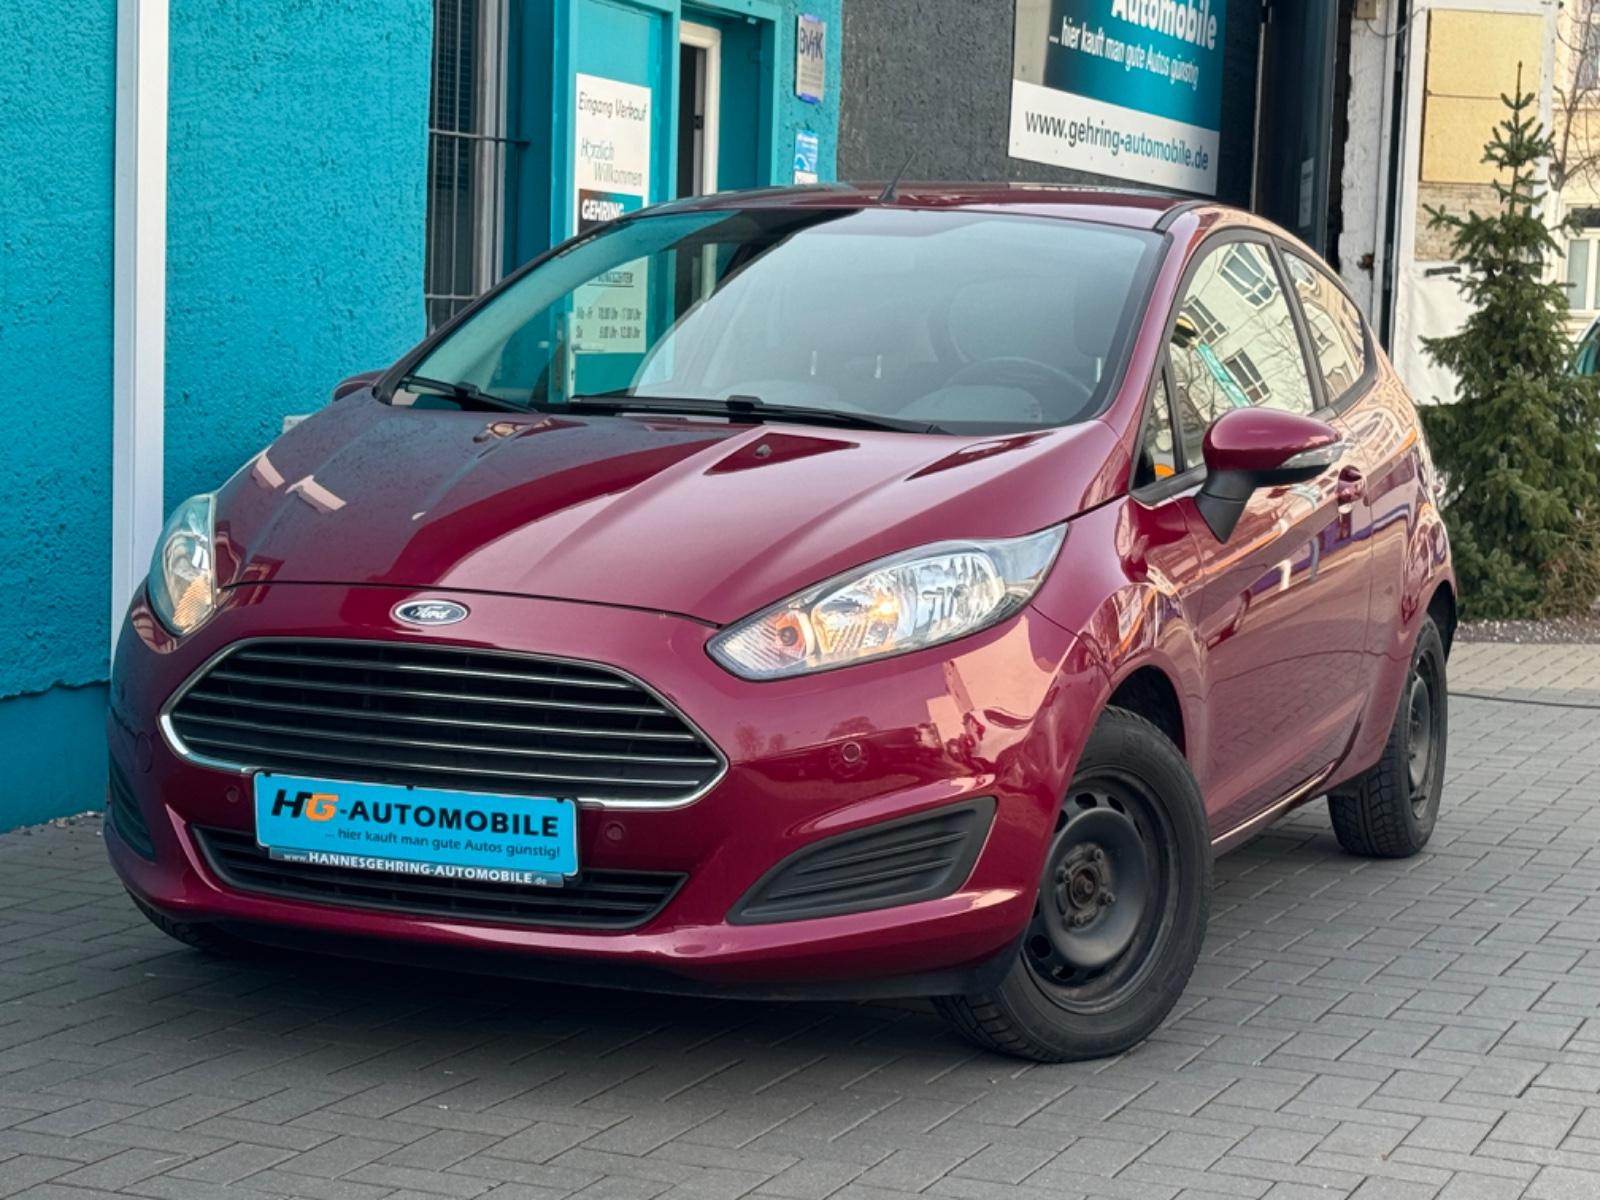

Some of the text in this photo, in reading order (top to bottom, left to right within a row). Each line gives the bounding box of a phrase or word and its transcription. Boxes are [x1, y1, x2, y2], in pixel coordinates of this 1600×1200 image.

[1061, 16, 1080, 49] hier
[1081, 22, 1105, 57] kauft
[1105, 36, 1125, 63] man
[1125, 43, 1145, 72] gute
[1146, 44, 1170, 76] Autos
[578, 91, 648, 122] Eingang Verkauf
[1025, 110, 1209, 171] www.gehring-automobile.de
[594, 161, 643, 187] Willkommen
[581, 199, 625, 222] GEHRING
[409, 605, 452, 620] Ford
[271, 788, 560, 838] HG-AUTOMOBILE
[338, 828, 363, 842] hier
[365, 831, 399, 845] kauft
[401, 835, 430, 847] man
[432, 837, 461, 852] gute
[464, 839, 503, 853] Autos
[506, 844, 560, 860] günstig!
[283, 851, 548, 886] www.HANNESGEHRING-AUTOMOBILE.de
